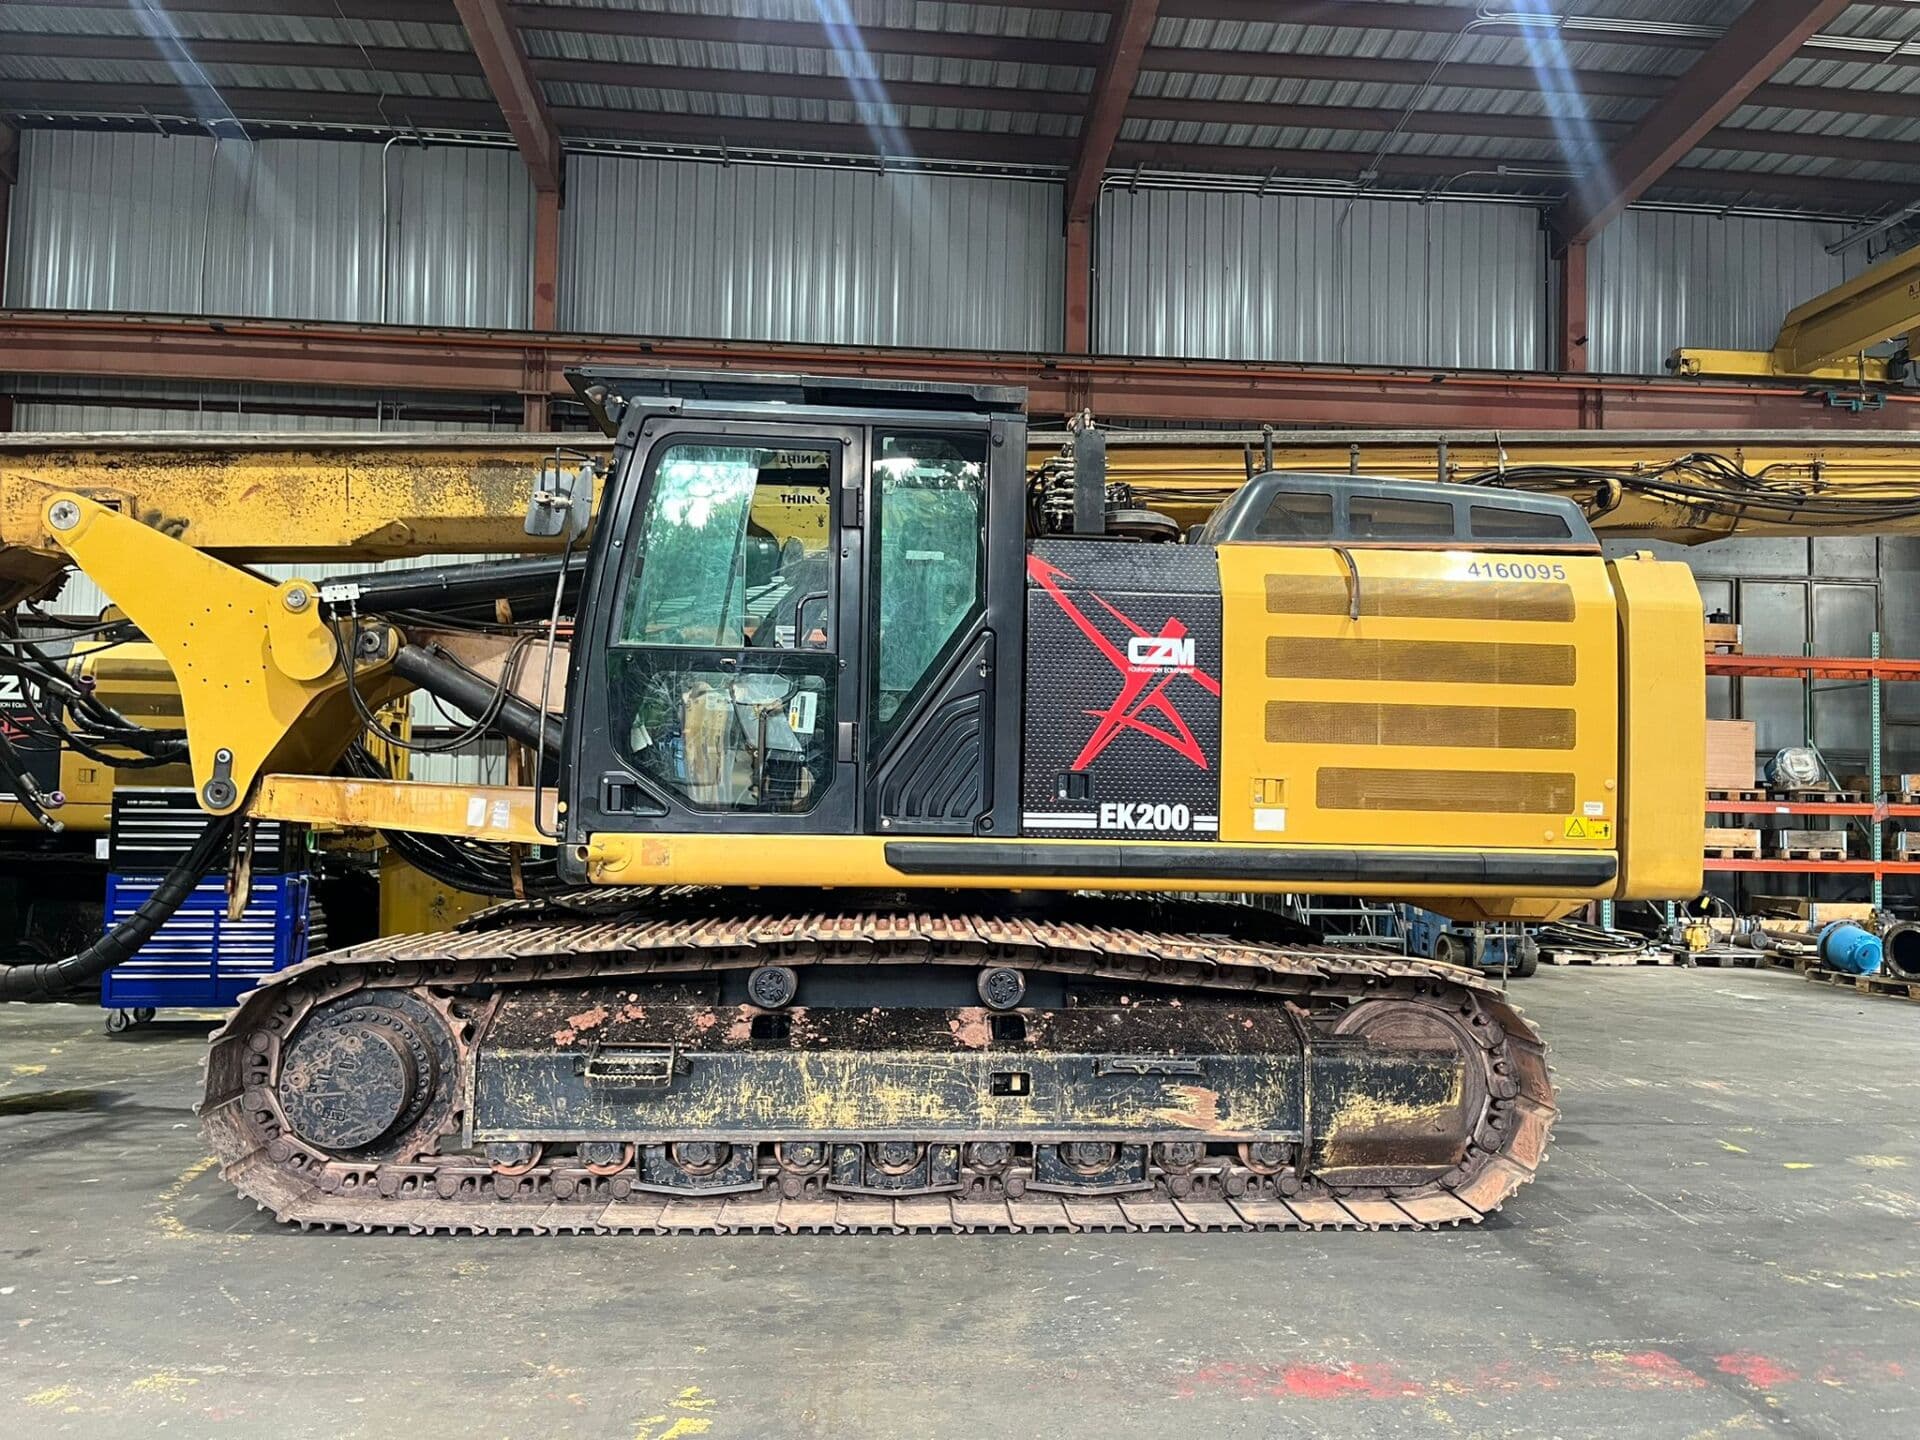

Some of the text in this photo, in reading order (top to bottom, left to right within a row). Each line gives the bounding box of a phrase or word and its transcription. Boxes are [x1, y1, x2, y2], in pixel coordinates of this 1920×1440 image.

[1468, 562, 1566, 580] 4160095
[1128, 637, 1195, 666] CZM
[1100, 803, 1190, 831] EK200
